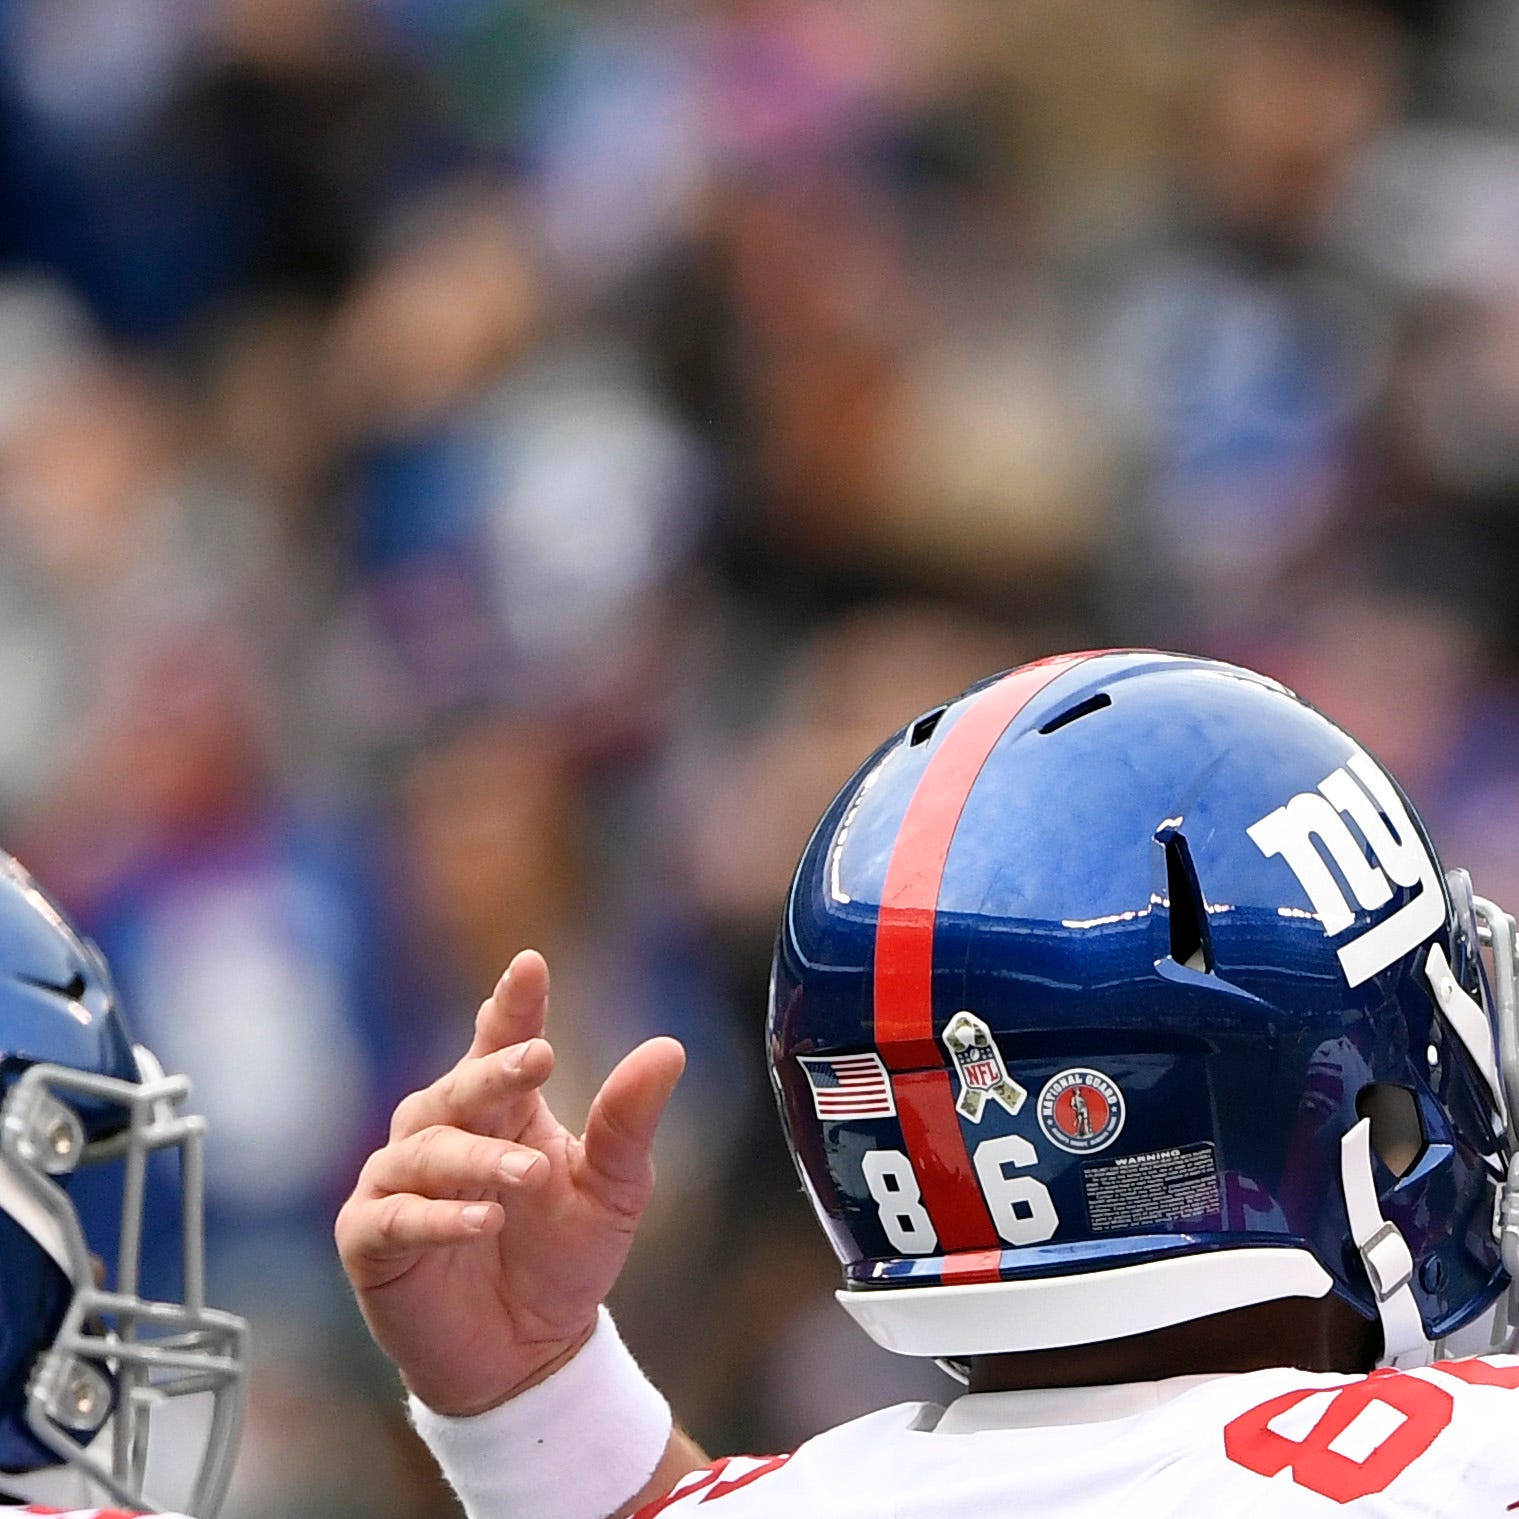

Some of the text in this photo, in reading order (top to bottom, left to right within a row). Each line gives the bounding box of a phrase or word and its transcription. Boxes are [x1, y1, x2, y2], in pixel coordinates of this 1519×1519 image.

[964, 1061, 999, 1087] NFL
[1043, 1074, 1118, 1116] NATIONAL GUARD
[1115, 1149, 1181, 1166] WARNING
